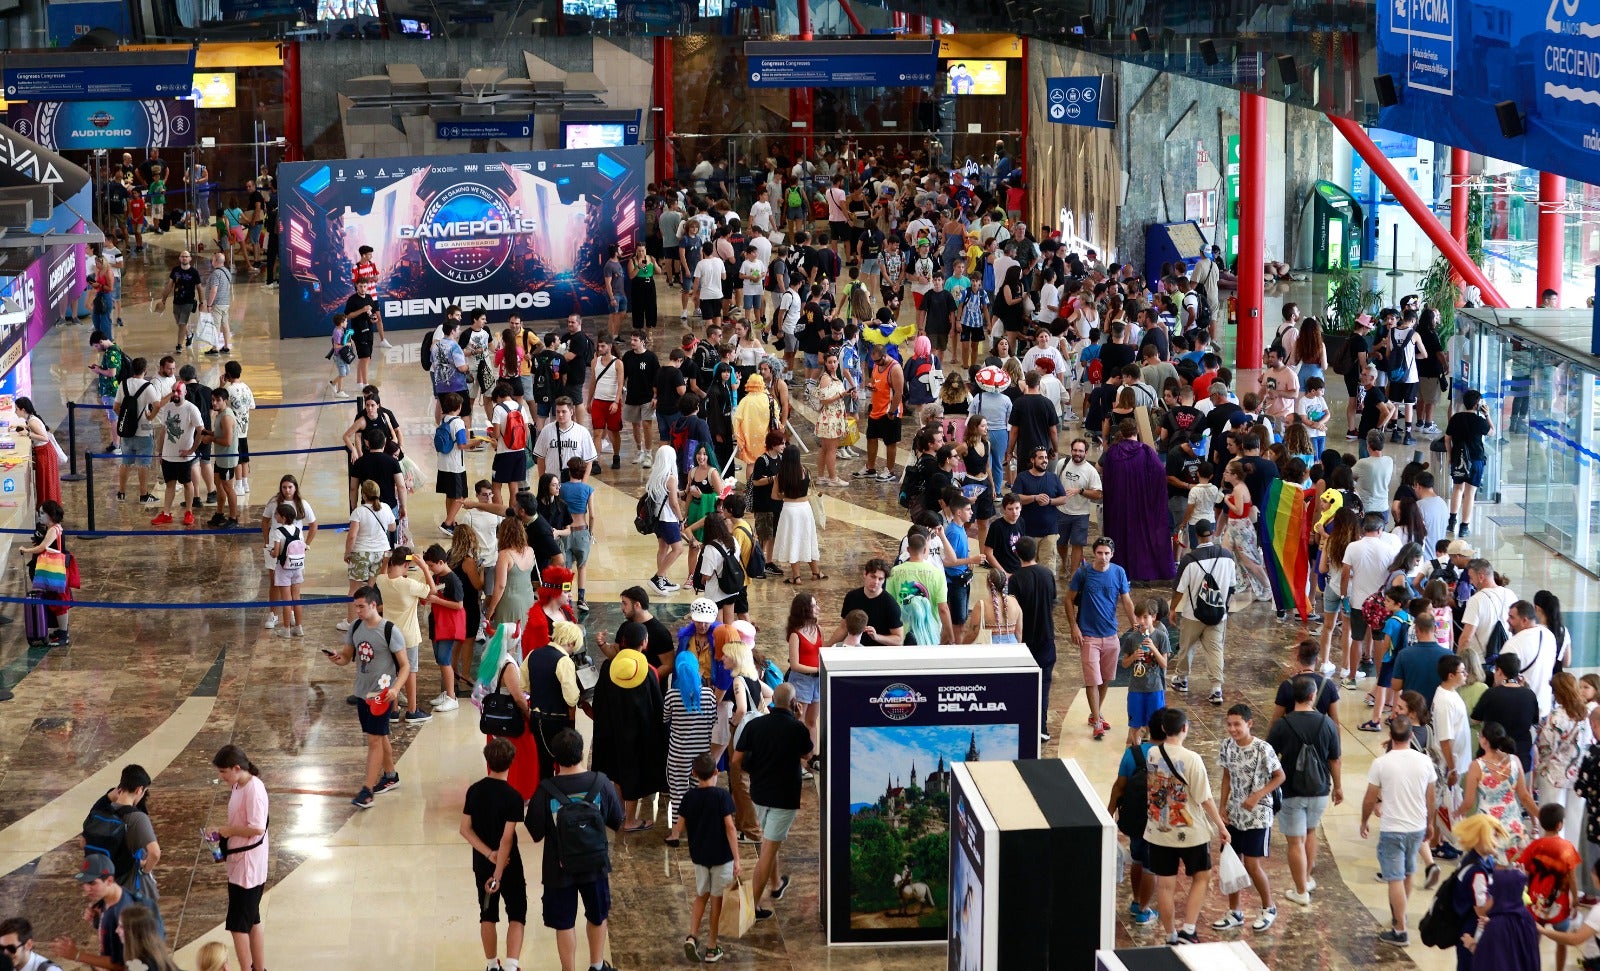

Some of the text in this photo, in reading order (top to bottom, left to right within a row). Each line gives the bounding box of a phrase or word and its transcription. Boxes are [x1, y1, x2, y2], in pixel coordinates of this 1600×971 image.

[1412, 0, 1449, 24] FYCMA
[71, 128, 132, 138] AUDITORIO
[522, 126, 530, 136] D
[448, 186, 470, 197] GAMING
[396, 215, 537, 239] GAMEPOLIS
[451, 240, 495, 248] ANIVERSARIO
[447, 267, 491, 281] MÁLAGA
[384, 291, 551, 318] BIENVENIDOS
[938, 692, 977, 702] LUNA
[938, 702, 1007, 712] DEL ALBA
